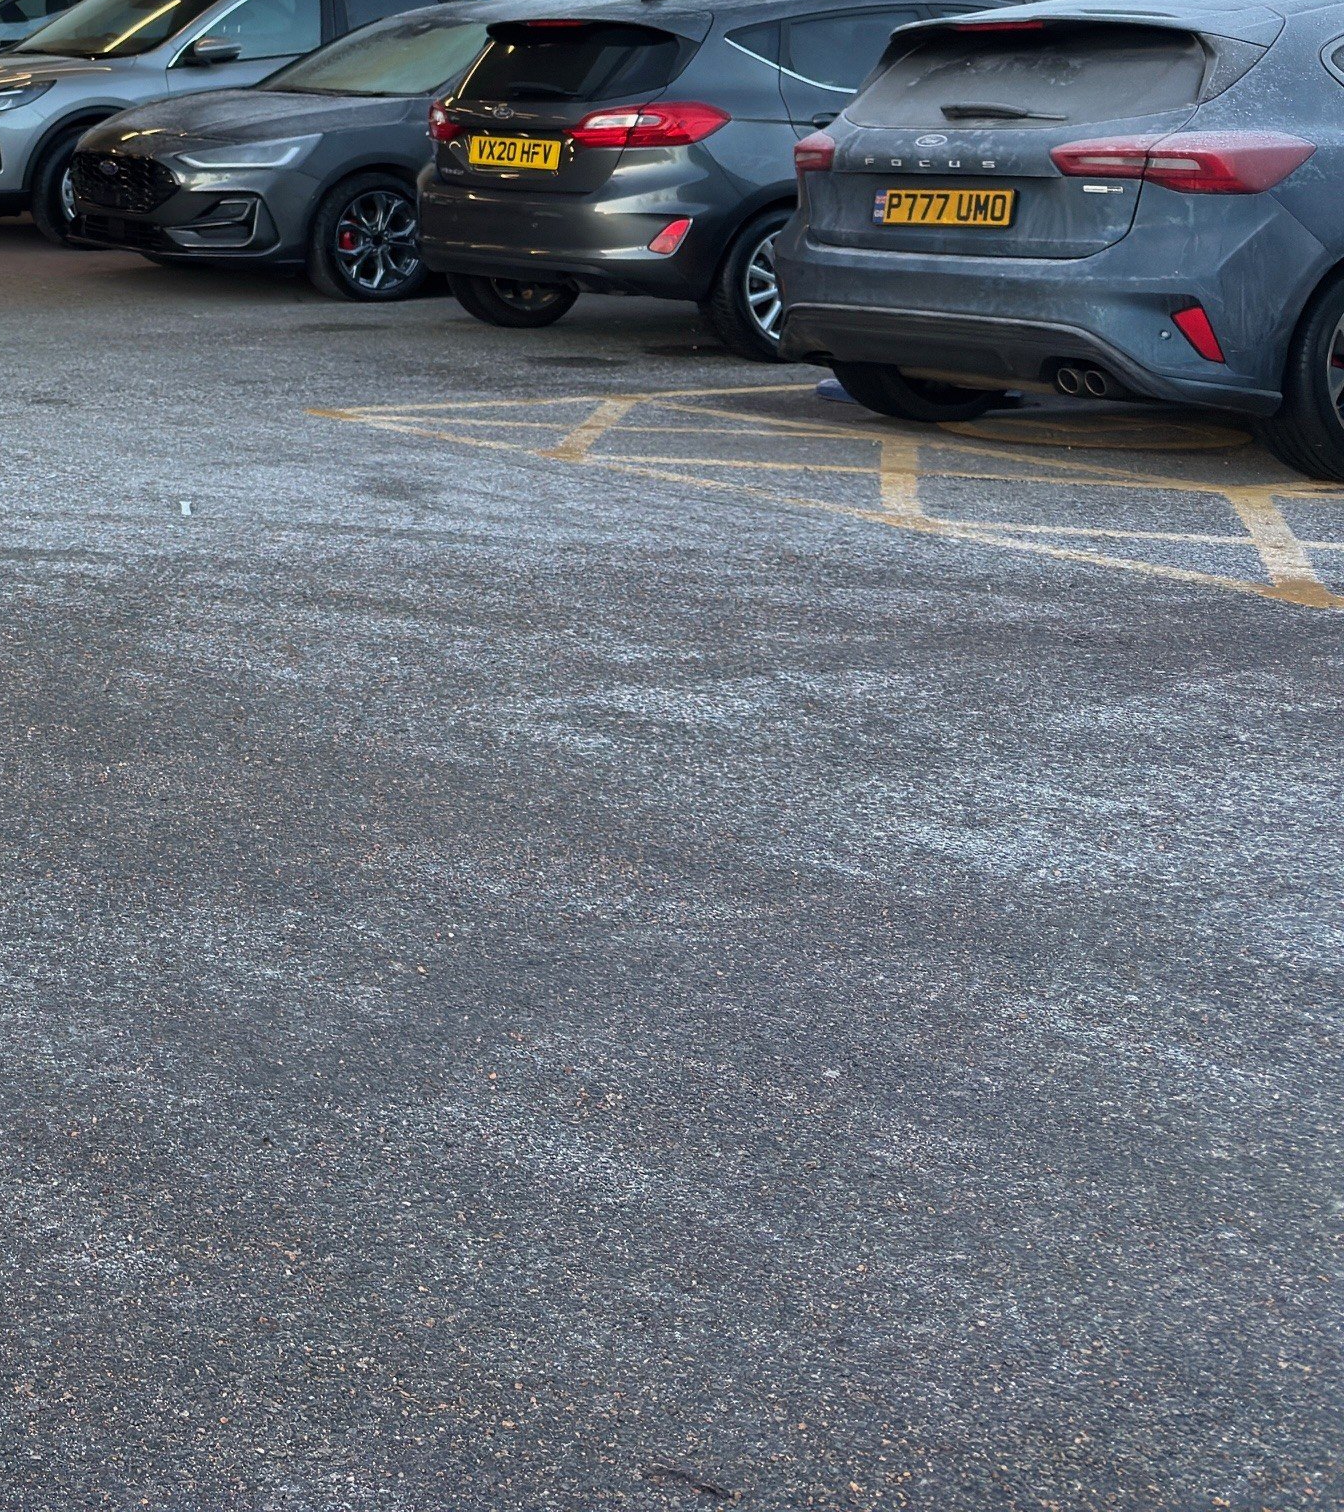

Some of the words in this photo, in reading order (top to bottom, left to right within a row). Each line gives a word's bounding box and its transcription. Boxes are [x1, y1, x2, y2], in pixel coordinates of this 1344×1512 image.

[478, 139, 516, 162] VX20
[520, 142, 553, 164] HFV
[865, 158, 996, 169] FOCUS
[886, 193, 949, 222] P777
[956, 193, 1008, 222] UMO
